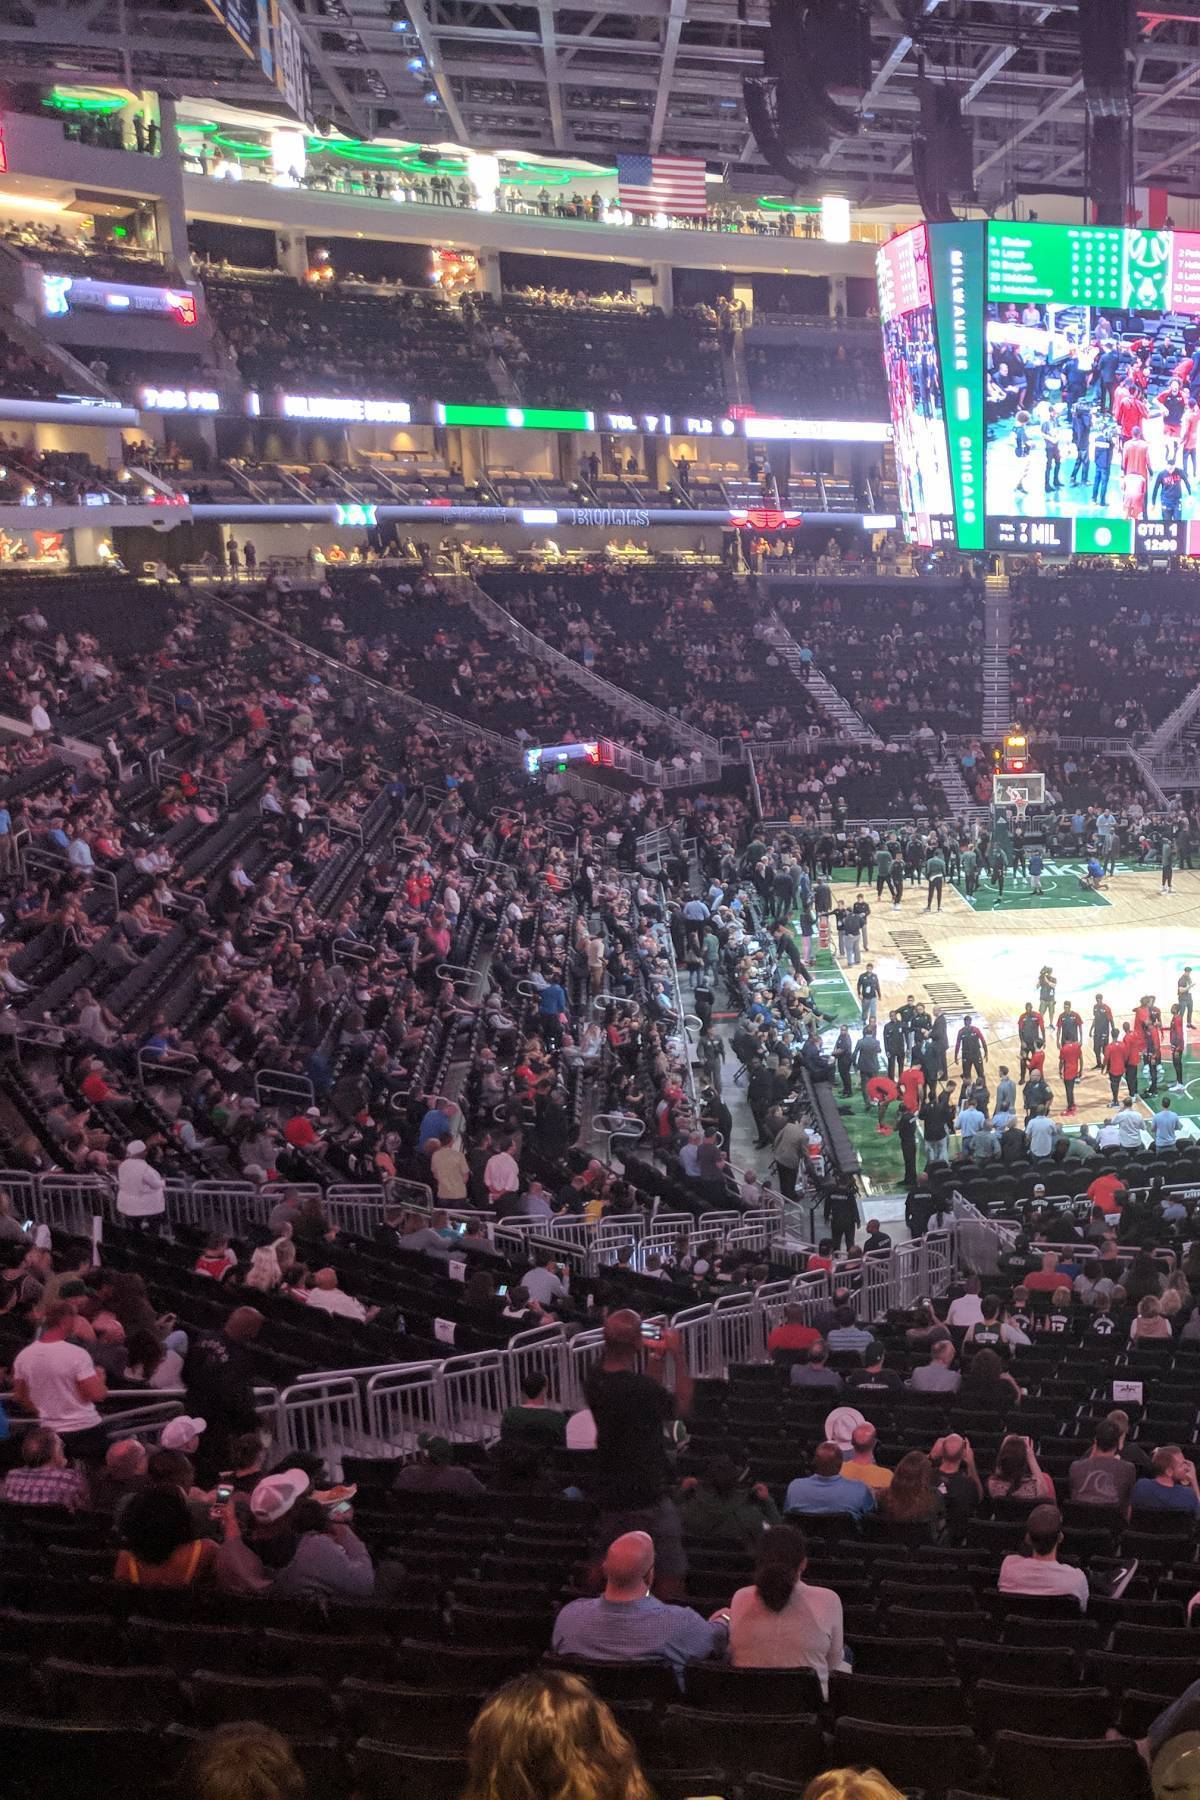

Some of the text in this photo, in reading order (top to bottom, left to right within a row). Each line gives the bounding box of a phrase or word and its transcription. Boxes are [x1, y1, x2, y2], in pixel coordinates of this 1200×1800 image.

[571, 508, 650, 526] BULLS
[1031, 523, 1061, 544] MIL
[1138, 523, 1178, 536] QTR 1
